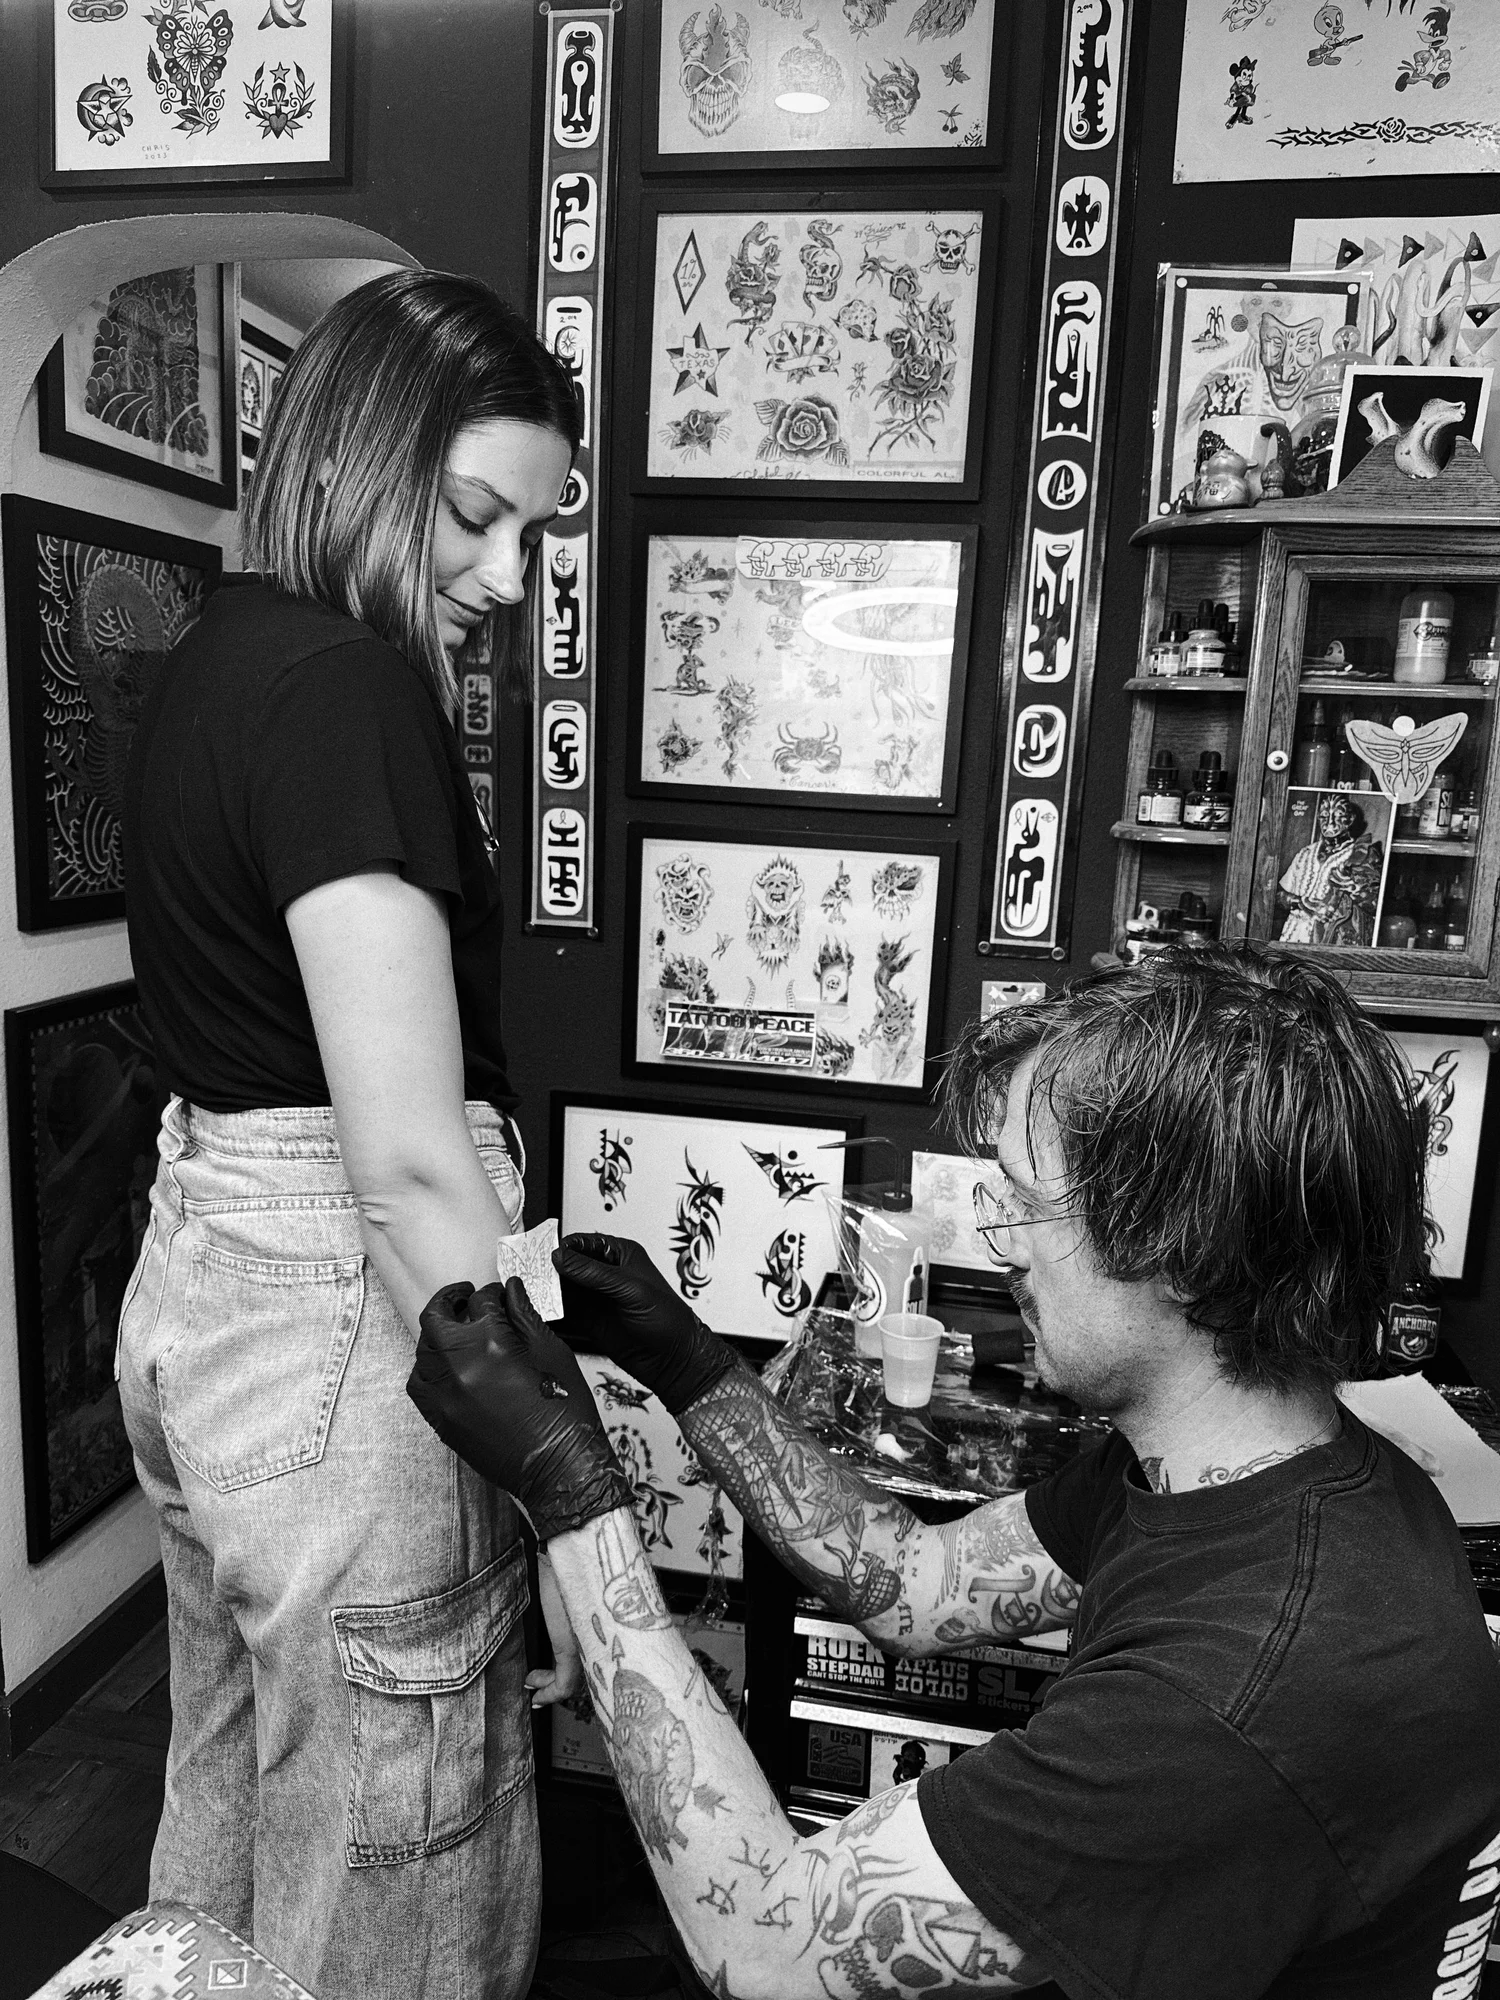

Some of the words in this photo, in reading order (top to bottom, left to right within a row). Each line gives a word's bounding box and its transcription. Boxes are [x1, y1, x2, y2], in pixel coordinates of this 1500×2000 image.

[141, 144, 170, 152] CHRIS
[679, 358, 716, 369] TEXAS
[857, 470, 927, 478] COLORFUL
[668, 1010, 746, 1029] TATTOO
[748, 1015, 815, 1034] PEACE
[807, 1657, 885, 1679] STEPDAD
[895, 1657, 969, 1681] APLUS
[807, 1669, 827, 1679] CANT
[828, 1672, 848, 1682] STOP
[849, 1675, 863, 1684] THE
[864, 1677, 885, 1687] BOYS
[978, 1695, 1030, 1713] Stickers
[830, 1729, 862, 1747] USA
